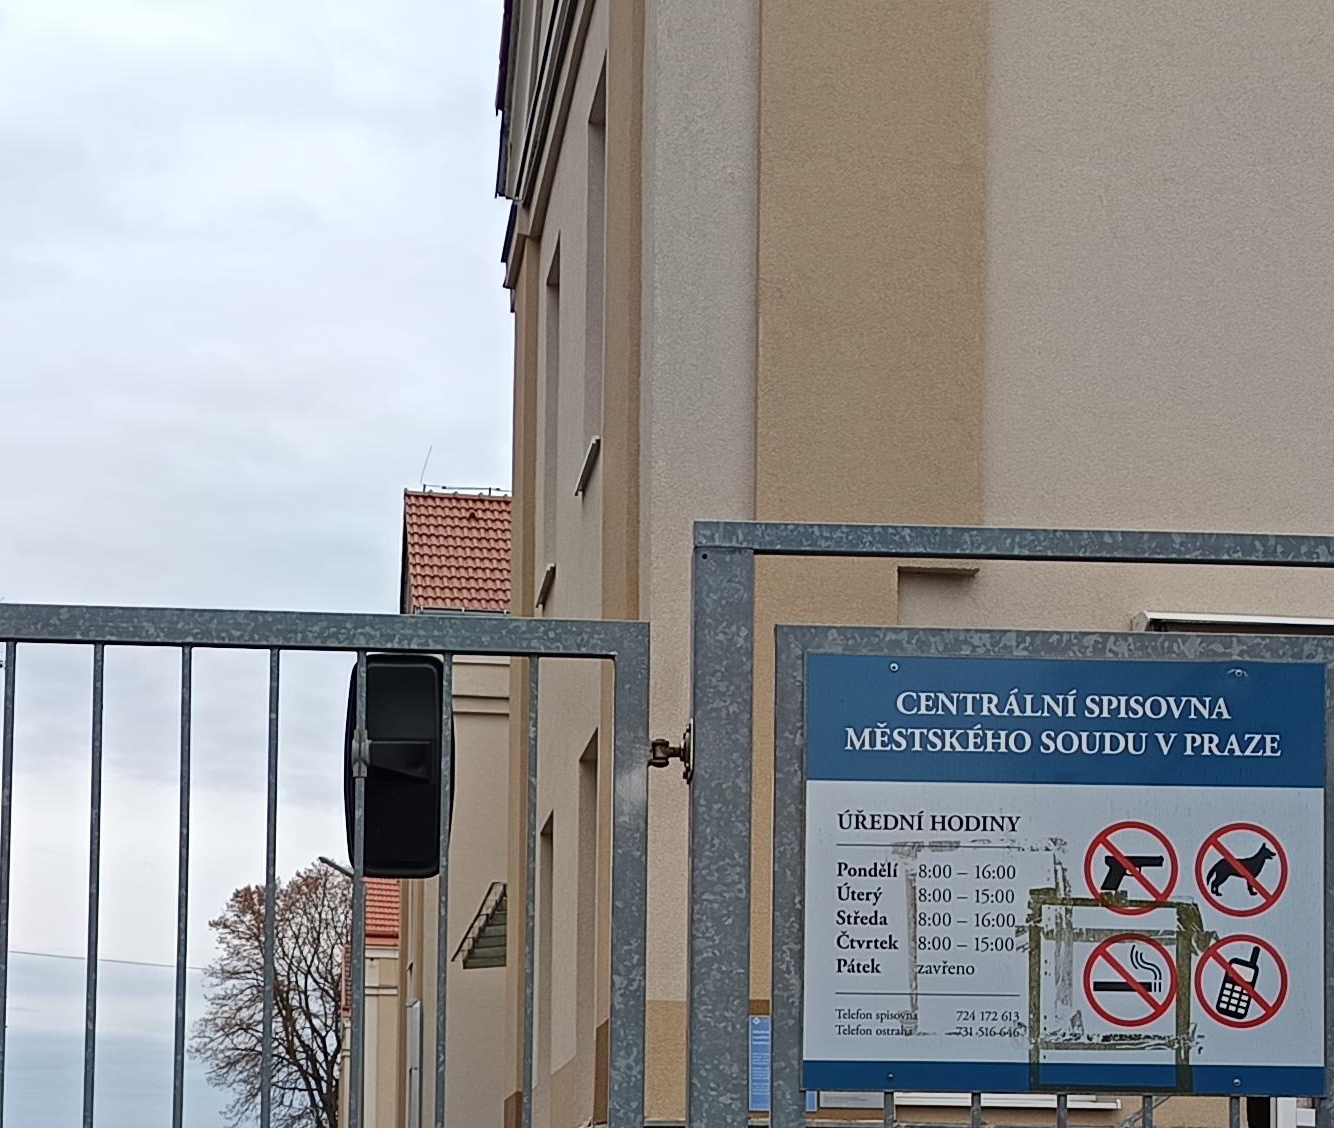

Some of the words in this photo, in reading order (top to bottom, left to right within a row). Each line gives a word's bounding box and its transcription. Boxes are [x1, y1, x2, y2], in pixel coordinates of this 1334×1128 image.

[896, 688, 1078, 718] CENTRÁLNÍ
[1084, 694, 1232, 720] SPISOVNA
[844, 722, 1033, 754] MĚSTSKÉHO
[1039, 730, 1149, 756] SOUDU
[1154, 732, 1178, 756] V
[1183, 732, 1282, 757] PRAZE
[837, 809, 925, 832] ÚŘEDNÍ
[929, 814, 1022, 832] HODINY
[836, 861, 900, 878] Pondělí
[918, 864, 952, 879] 8:00
[974, 864, 1016, 880] 16:00
[836, 882, 883, 906] Úterý
[917, 888, 952, 903] 8:00
[974, 888, 1015, 904] 15:00
[835, 909, 889, 926] Středa
[917, 912, 952, 927] 8:00
[974, 912, 1016, 928] 16:00
[835, 930, 900, 950] Čtvrtek
[917, 936, 952, 951] 8:00
[974, 936, 1015, 952] 15:00
[835, 957, 882, 974] Pátek
[916, 960, 975, 976] zavřeno
[835, 1008, 873, 1021] Telefon
[875, 1009, 918, 1023] spisovna
[956, 1010, 976, 1022] 724
[980, 1010, 998, 1022] 172
[1001, 1010, 1020, 1023] 613
[835, 1024, 873, 1037] Telefon
[875, 1024, 913, 1037] ostraha
